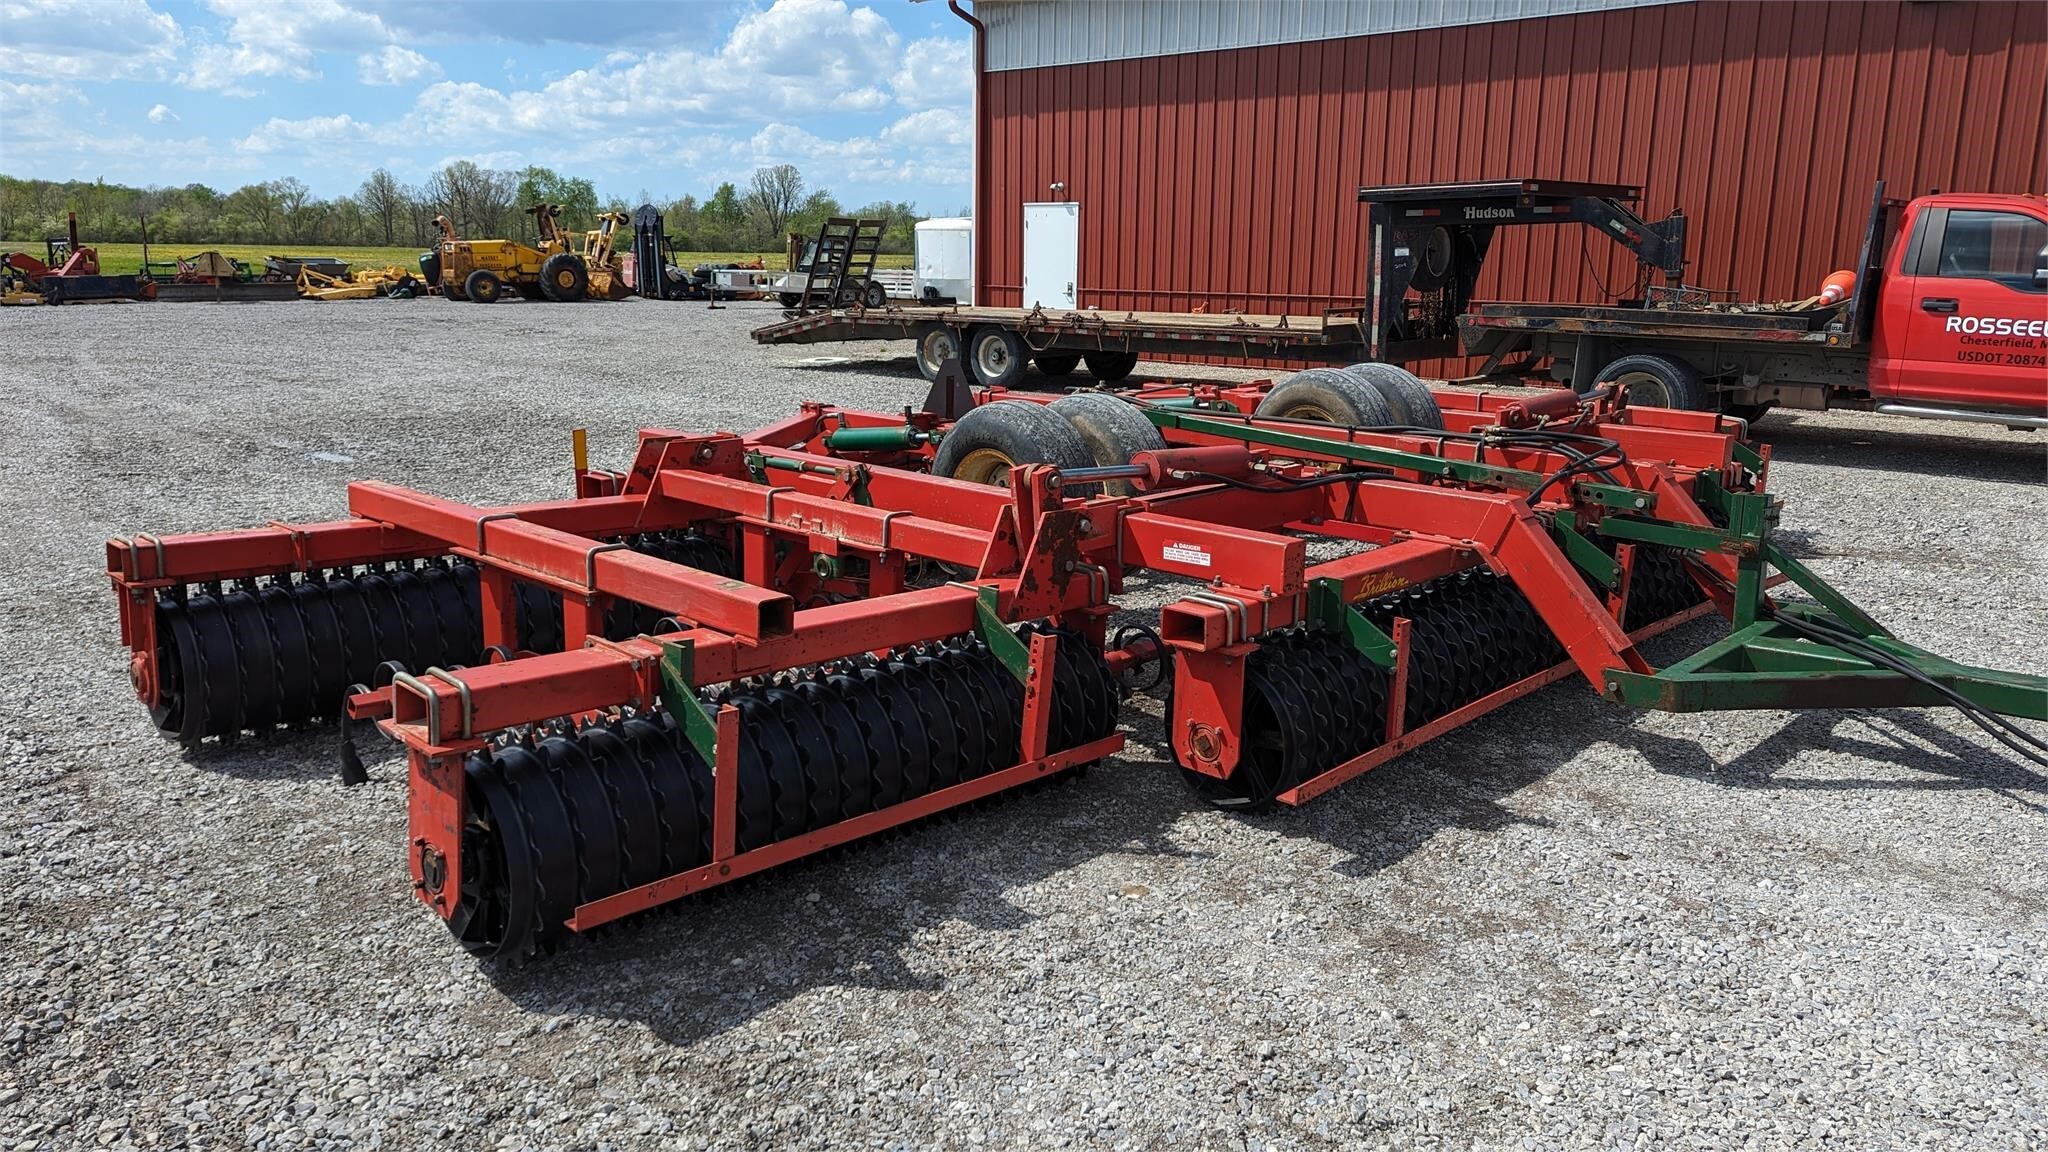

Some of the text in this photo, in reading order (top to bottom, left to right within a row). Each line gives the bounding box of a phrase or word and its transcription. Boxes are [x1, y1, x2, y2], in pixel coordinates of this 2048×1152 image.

[1463, 206, 1515, 219] Hudson
[1960, 335, 2037, 349] Chesterfield,
[1957, 351, 2047, 367] USDOT 20874
[1178, 542, 1201, 551] DANGER
